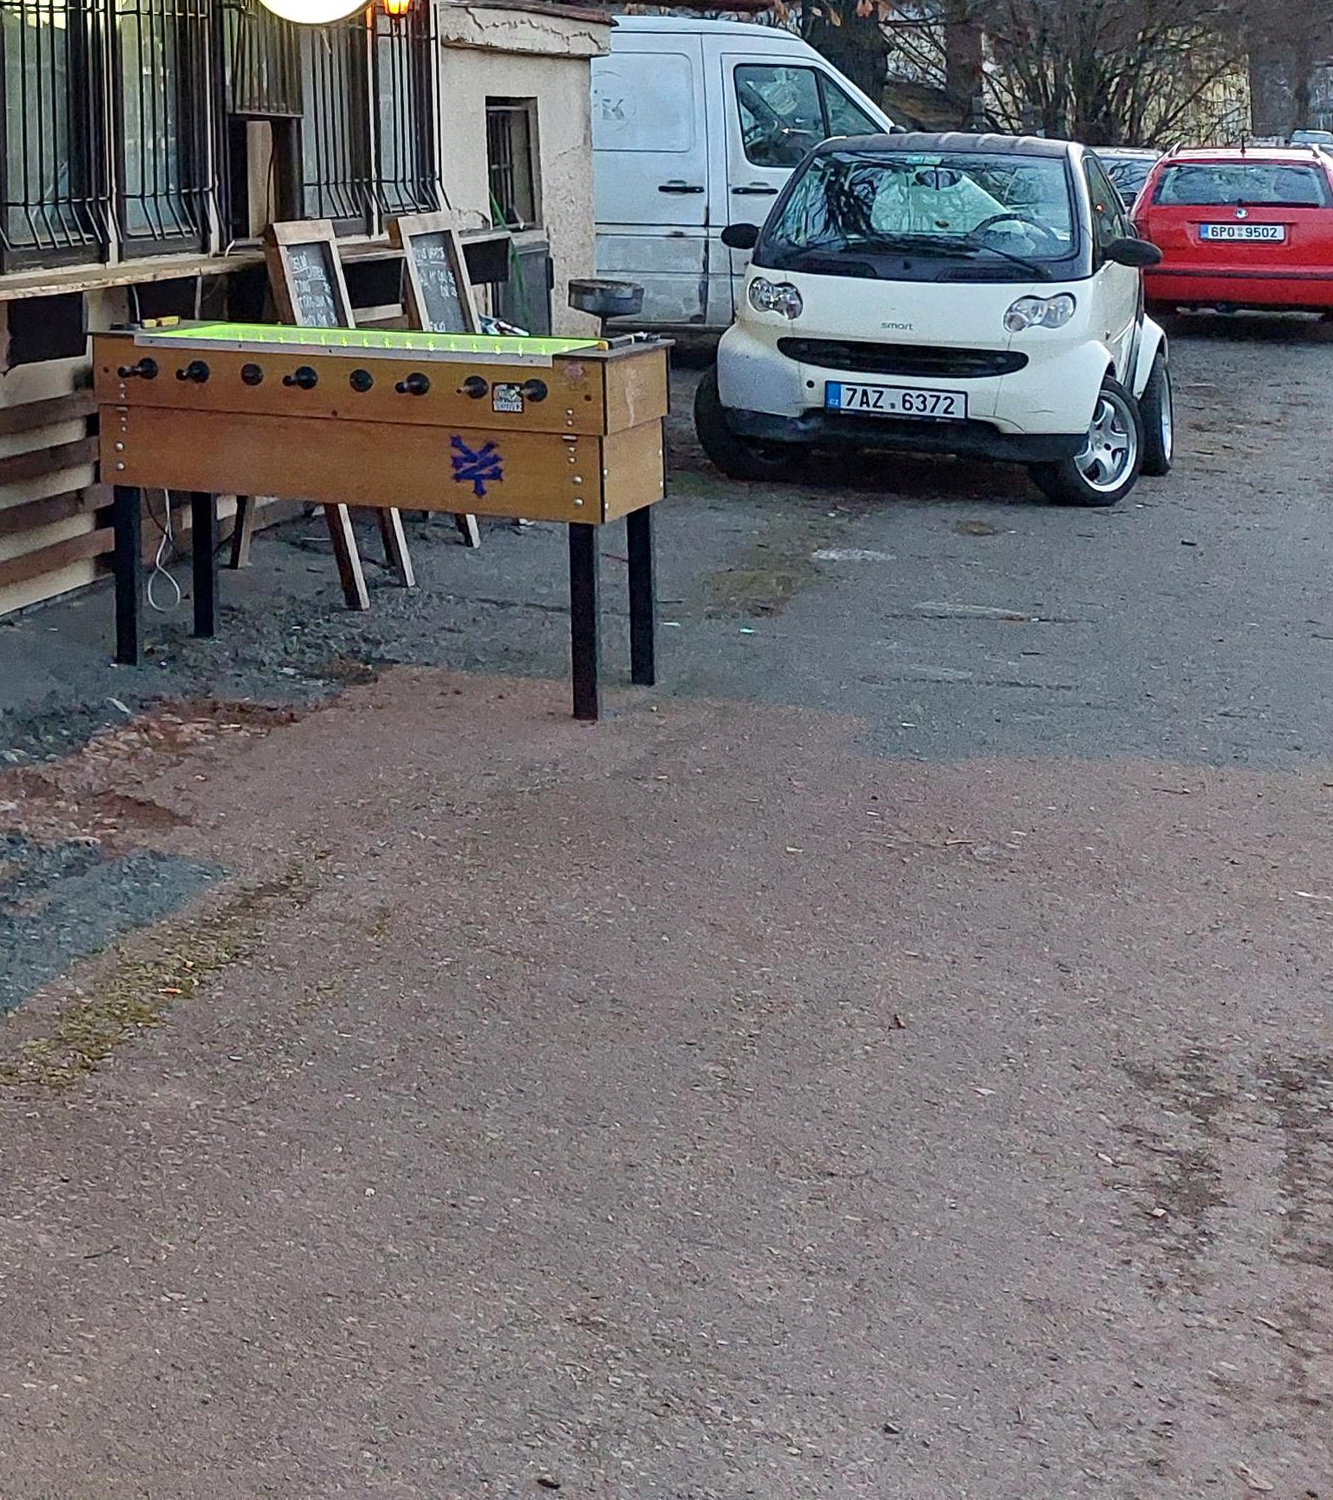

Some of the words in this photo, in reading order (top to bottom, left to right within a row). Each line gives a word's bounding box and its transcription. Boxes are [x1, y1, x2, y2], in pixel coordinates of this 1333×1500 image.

[1245, 227, 1278, 238] 9502
[881, 322, 913, 331] smart
[845, 387, 884, 409] 7AZ
[902, 393, 955, 415] 6372
